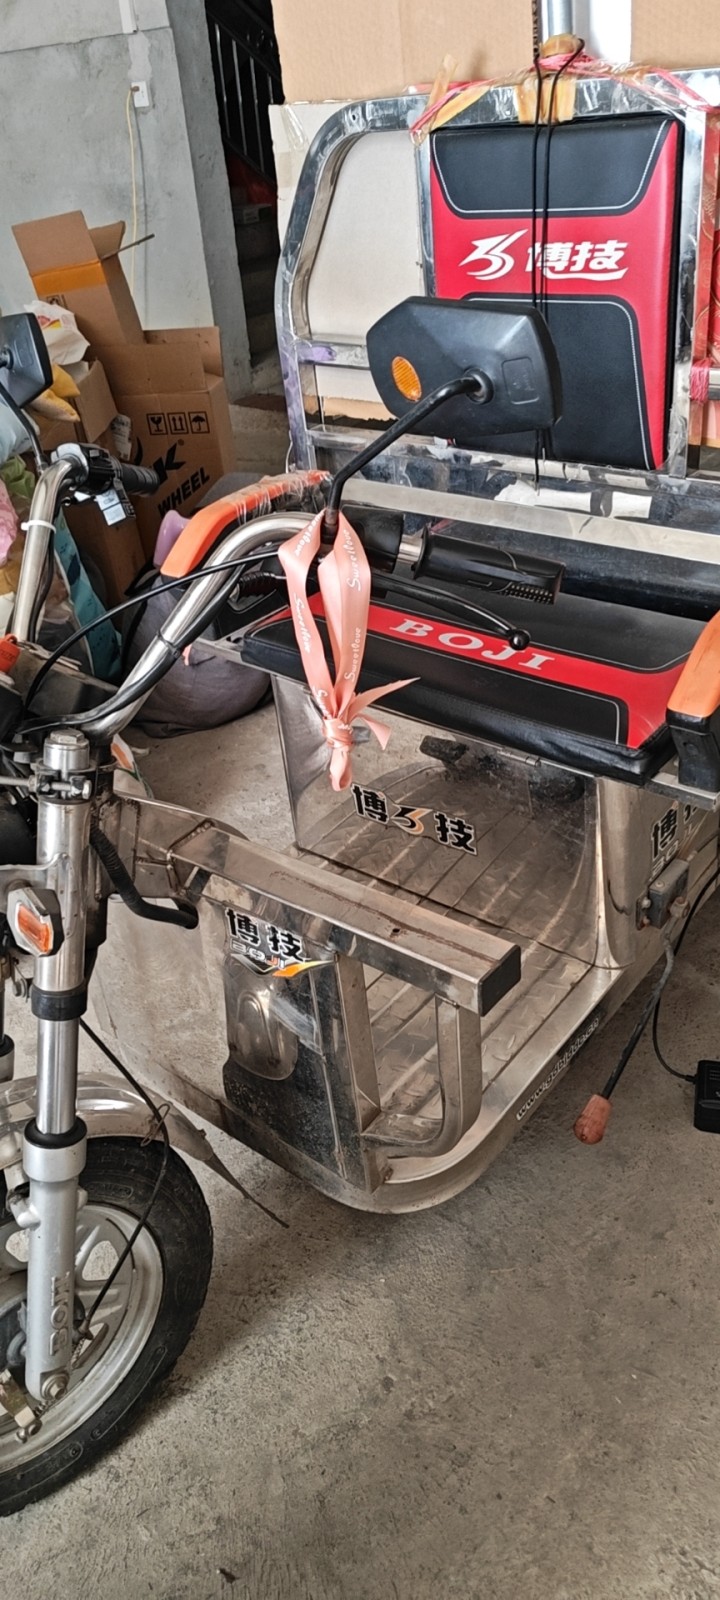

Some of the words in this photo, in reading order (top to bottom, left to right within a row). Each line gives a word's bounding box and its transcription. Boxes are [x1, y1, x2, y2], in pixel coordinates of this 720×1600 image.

[525, 240, 628, 274] 博技
[157, 466, 211, 518] WHEEL
[390, 618, 555, 670] BOJI
[225, 908, 311, 961] 博技
